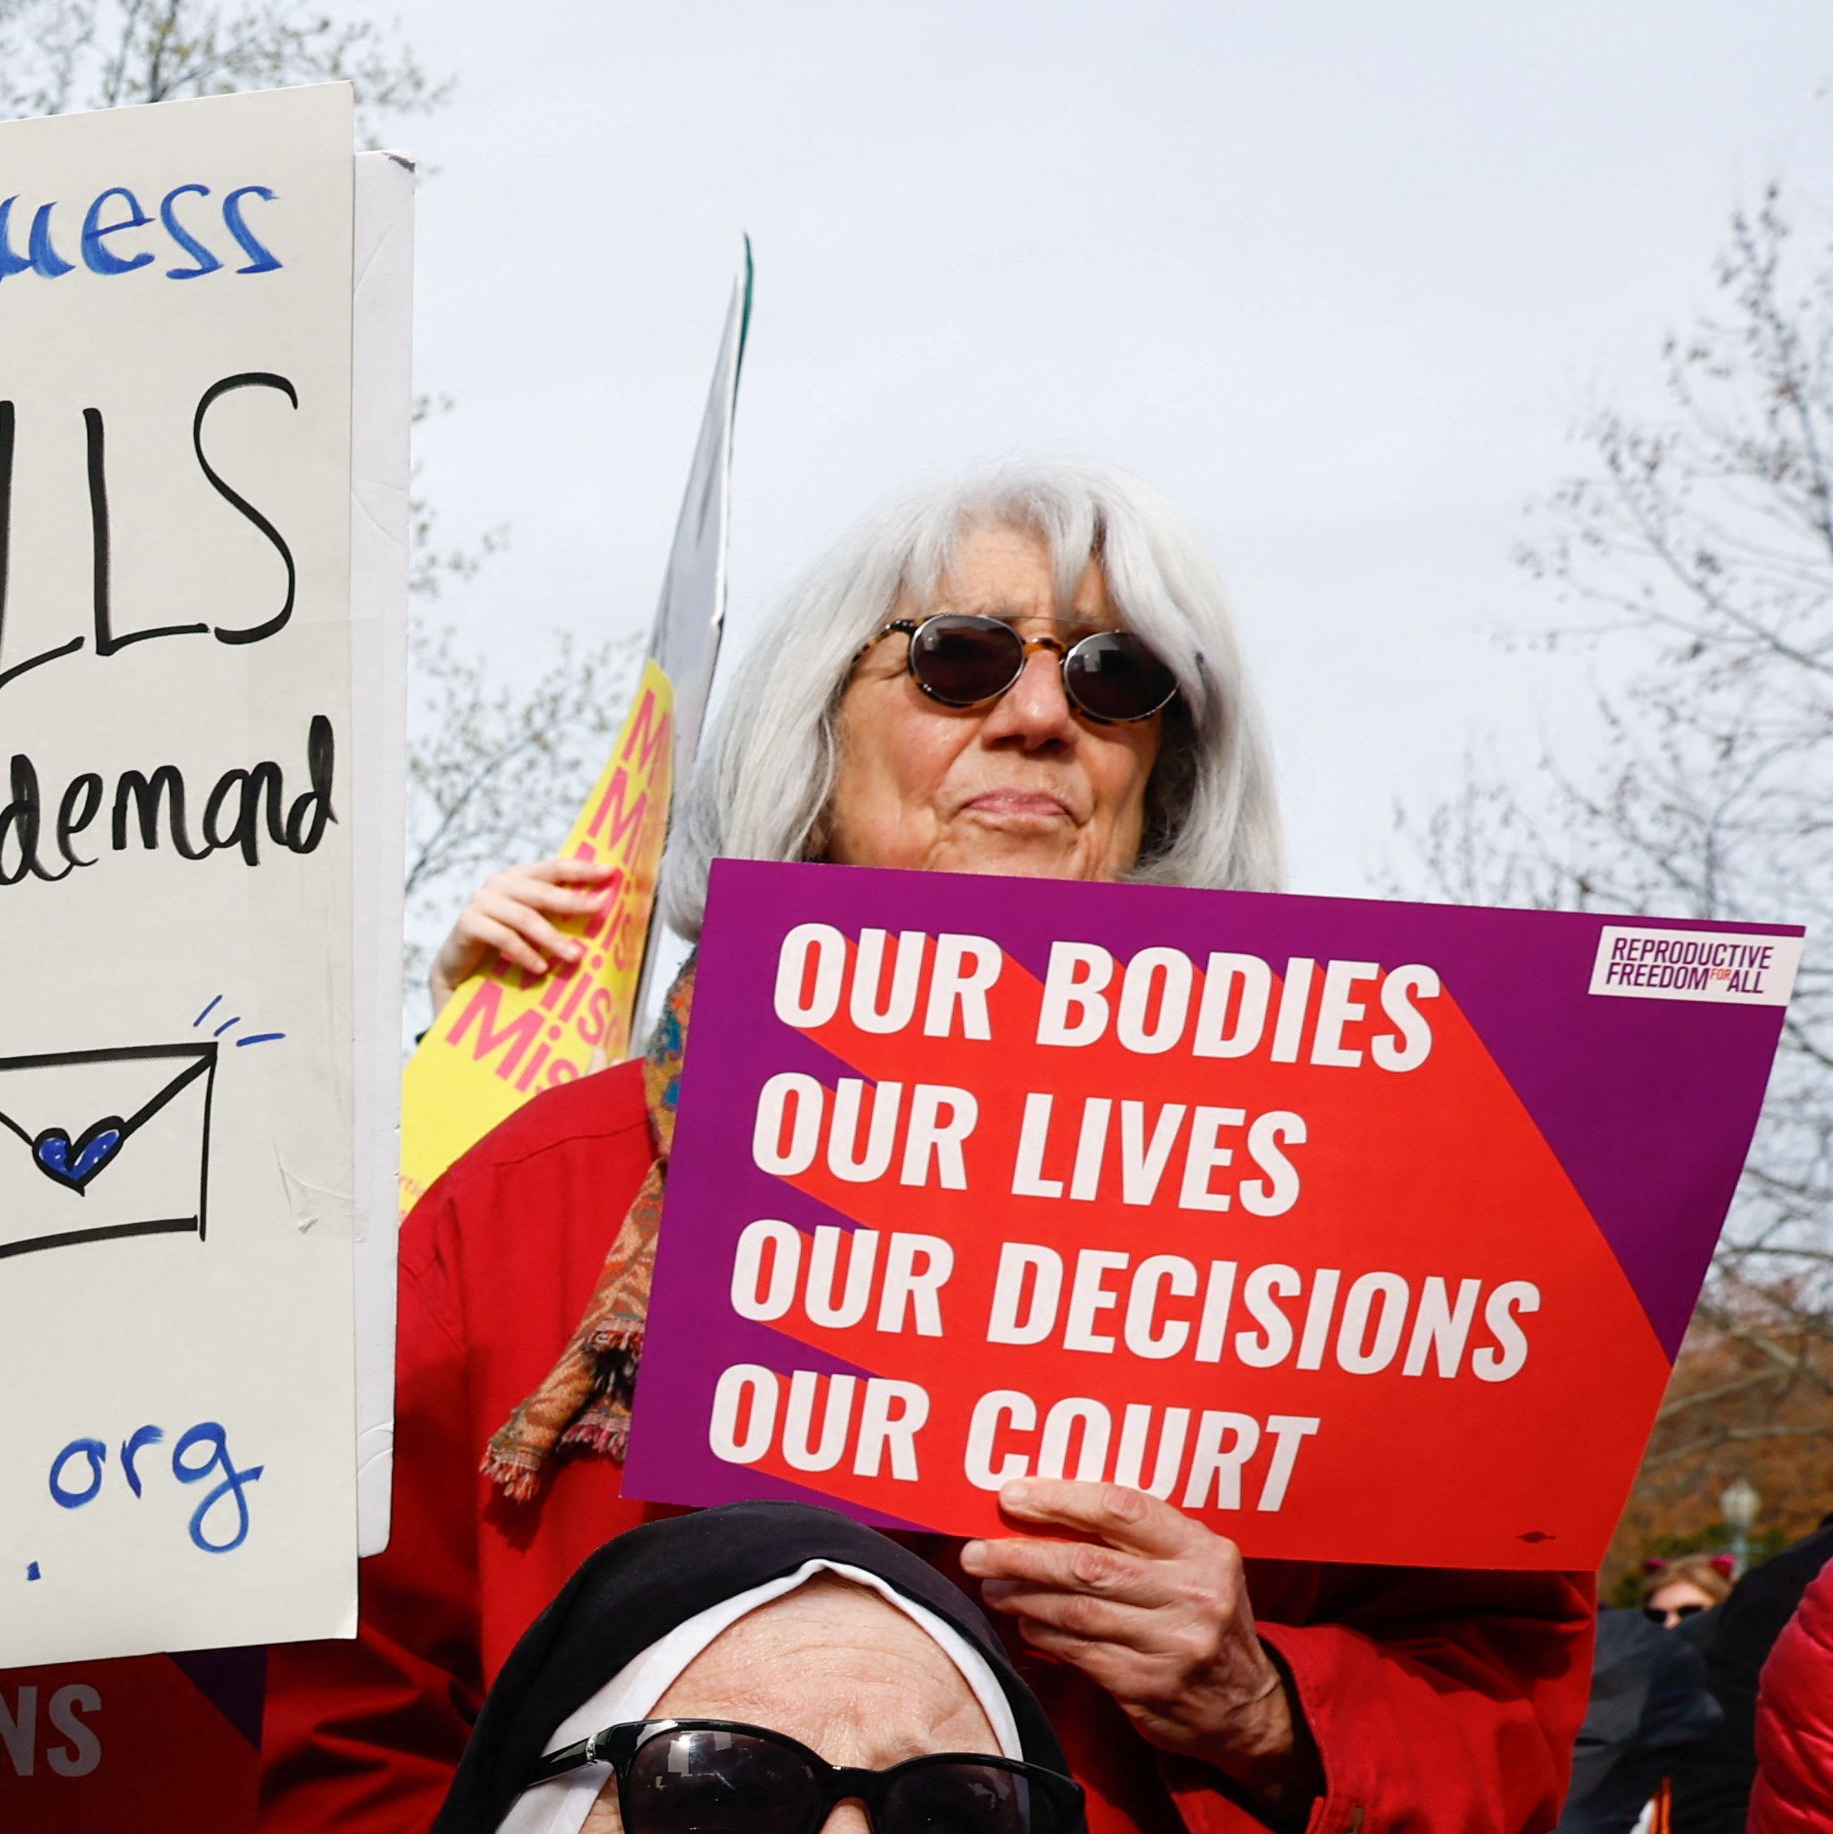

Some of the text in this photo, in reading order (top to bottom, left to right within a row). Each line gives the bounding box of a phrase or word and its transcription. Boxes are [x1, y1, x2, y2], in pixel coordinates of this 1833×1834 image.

[774, 923, 1441, 1073] OUR BODIES
[1605, 962, 1711, 991] FREEDOM
[1726, 970, 1765, 994] ALL
[1611, 937, 1774, 970] REPRODUCTIVE
[752, 1072, 1308, 1217] OUR LIVES
[731, 1219, 1541, 1383] OUR DECISIONS
[709, 1363, 1321, 1512] OUR COURT
